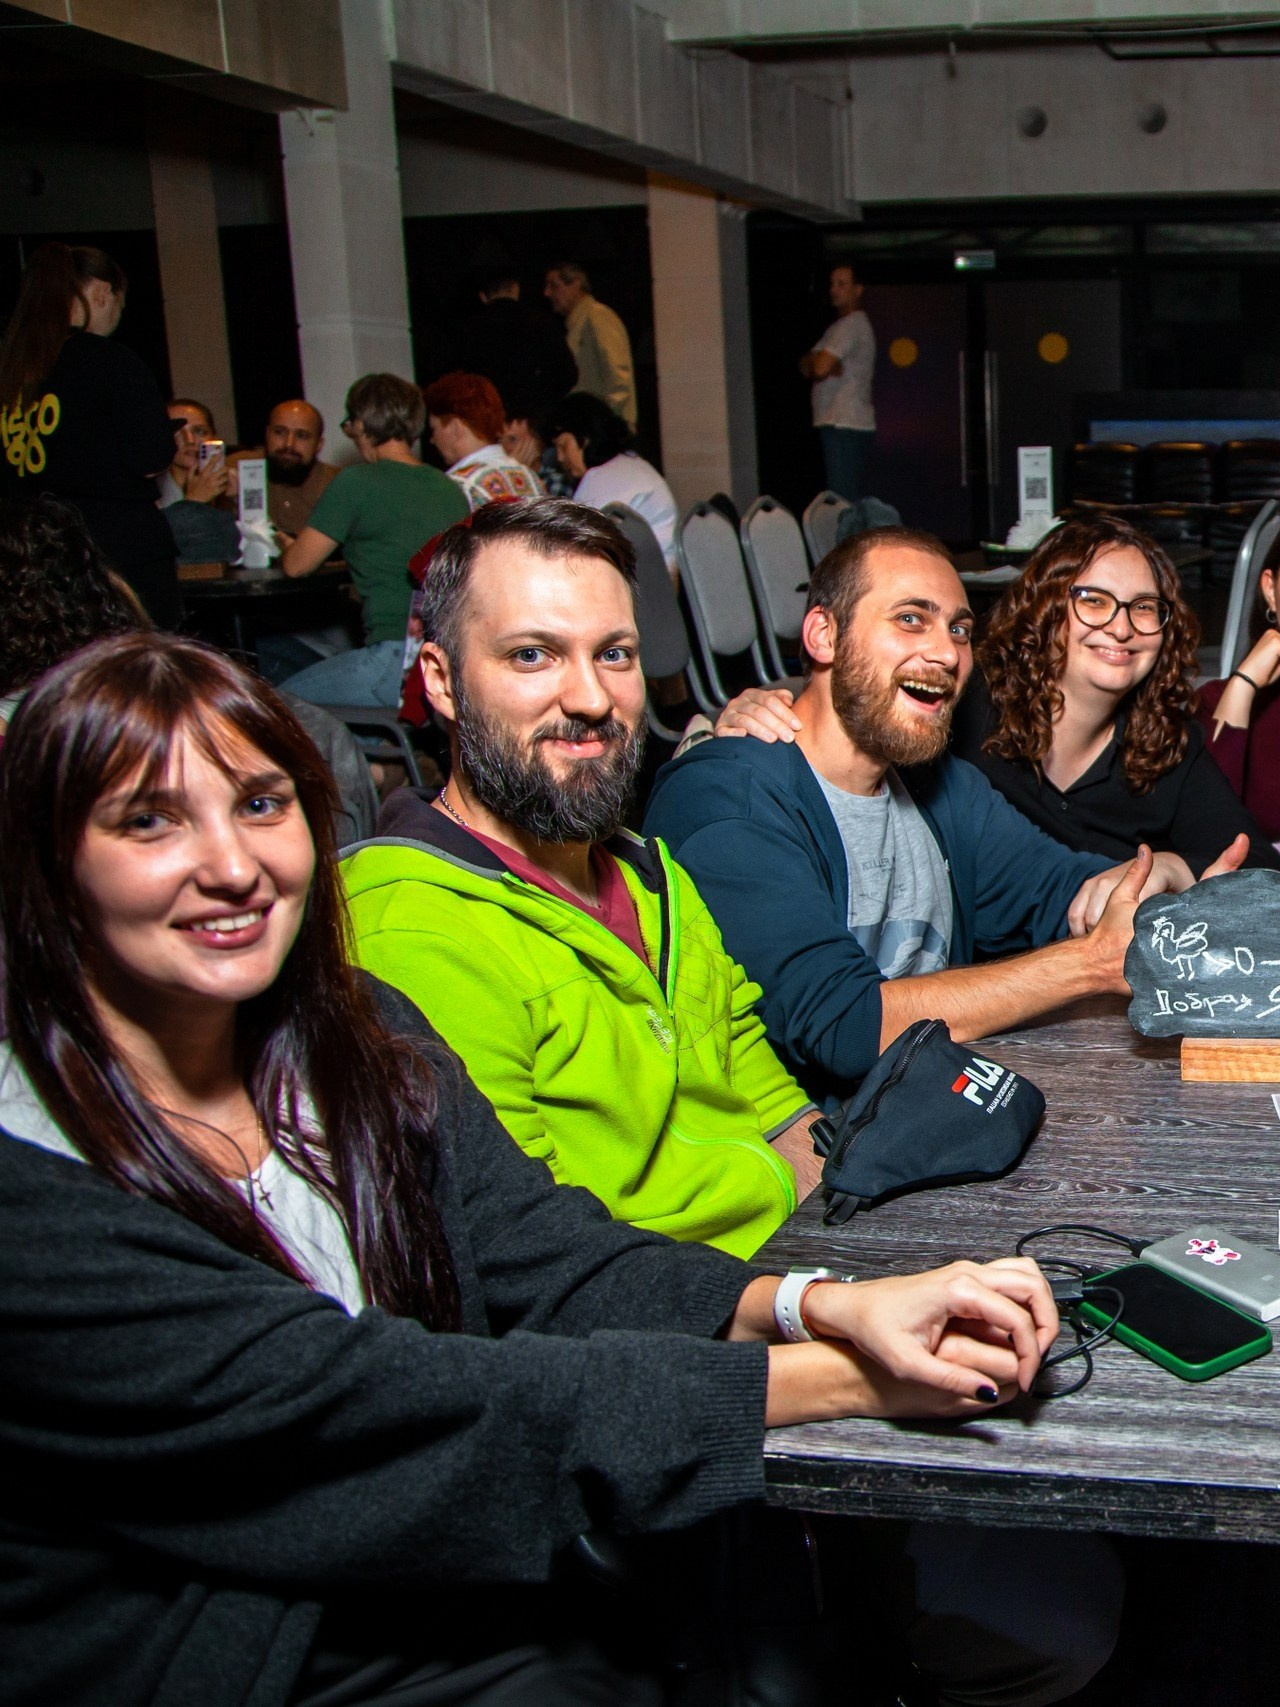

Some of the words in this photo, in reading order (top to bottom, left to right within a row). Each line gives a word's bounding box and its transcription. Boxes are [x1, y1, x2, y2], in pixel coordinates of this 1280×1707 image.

[0, 393, 60, 448] ISCO
[7, 434, 46, 477] 90
[1152, 986, 1253, 1018] Добрая
[951, 1057, 1005, 1106] FILA
